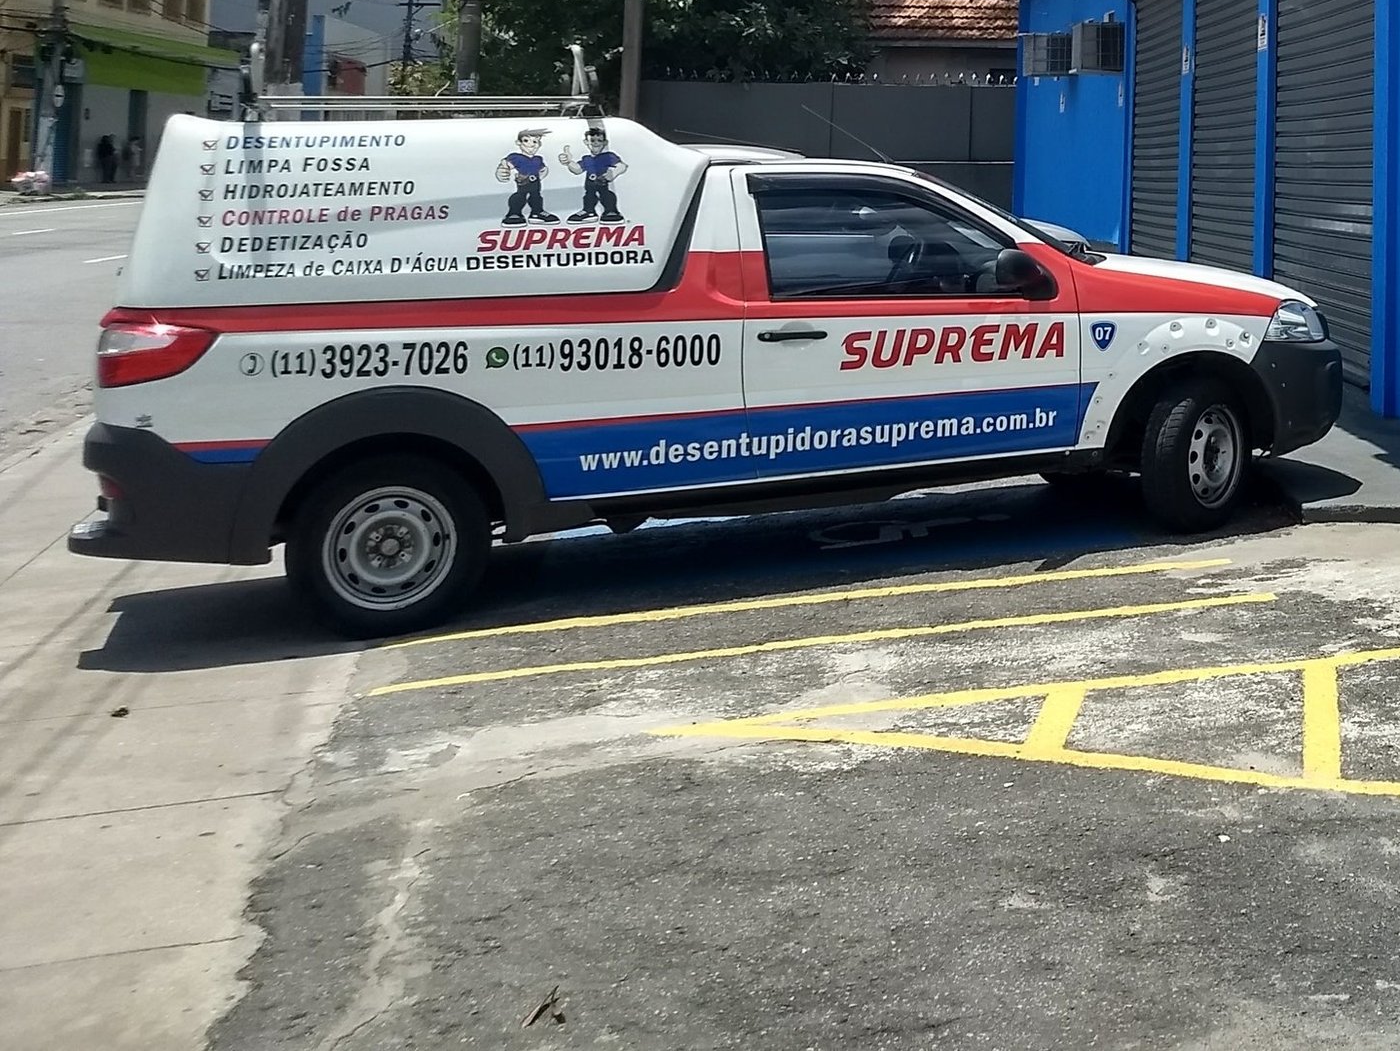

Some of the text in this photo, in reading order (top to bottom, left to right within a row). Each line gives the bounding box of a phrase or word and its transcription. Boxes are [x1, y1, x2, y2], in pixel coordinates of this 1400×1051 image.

[226, 134, 406, 150] DESENTUPIMENTO
[224, 157, 371, 175] LIMPA FOSSA
[223, 180, 415, 200] HIDROJATEAMENTO
[222, 205, 450, 226] CONTROLE de PRAGAS
[220, 230, 369, 254] DEDETIZAÇÃO
[477, 225, 645, 253] SUPREMA
[217, 262, 296, 280] LIMPEZA
[302, 260, 325, 277] de
[332, 259, 384, 276] CAIXA
[466, 249, 655, 271] DESENTUPIDORA
[1095, 326, 1112, 341] 07
[839, 321, 1066, 371] SUPREMA
[579, 407, 1058, 471] www.desentupidorasuprema.com.br
